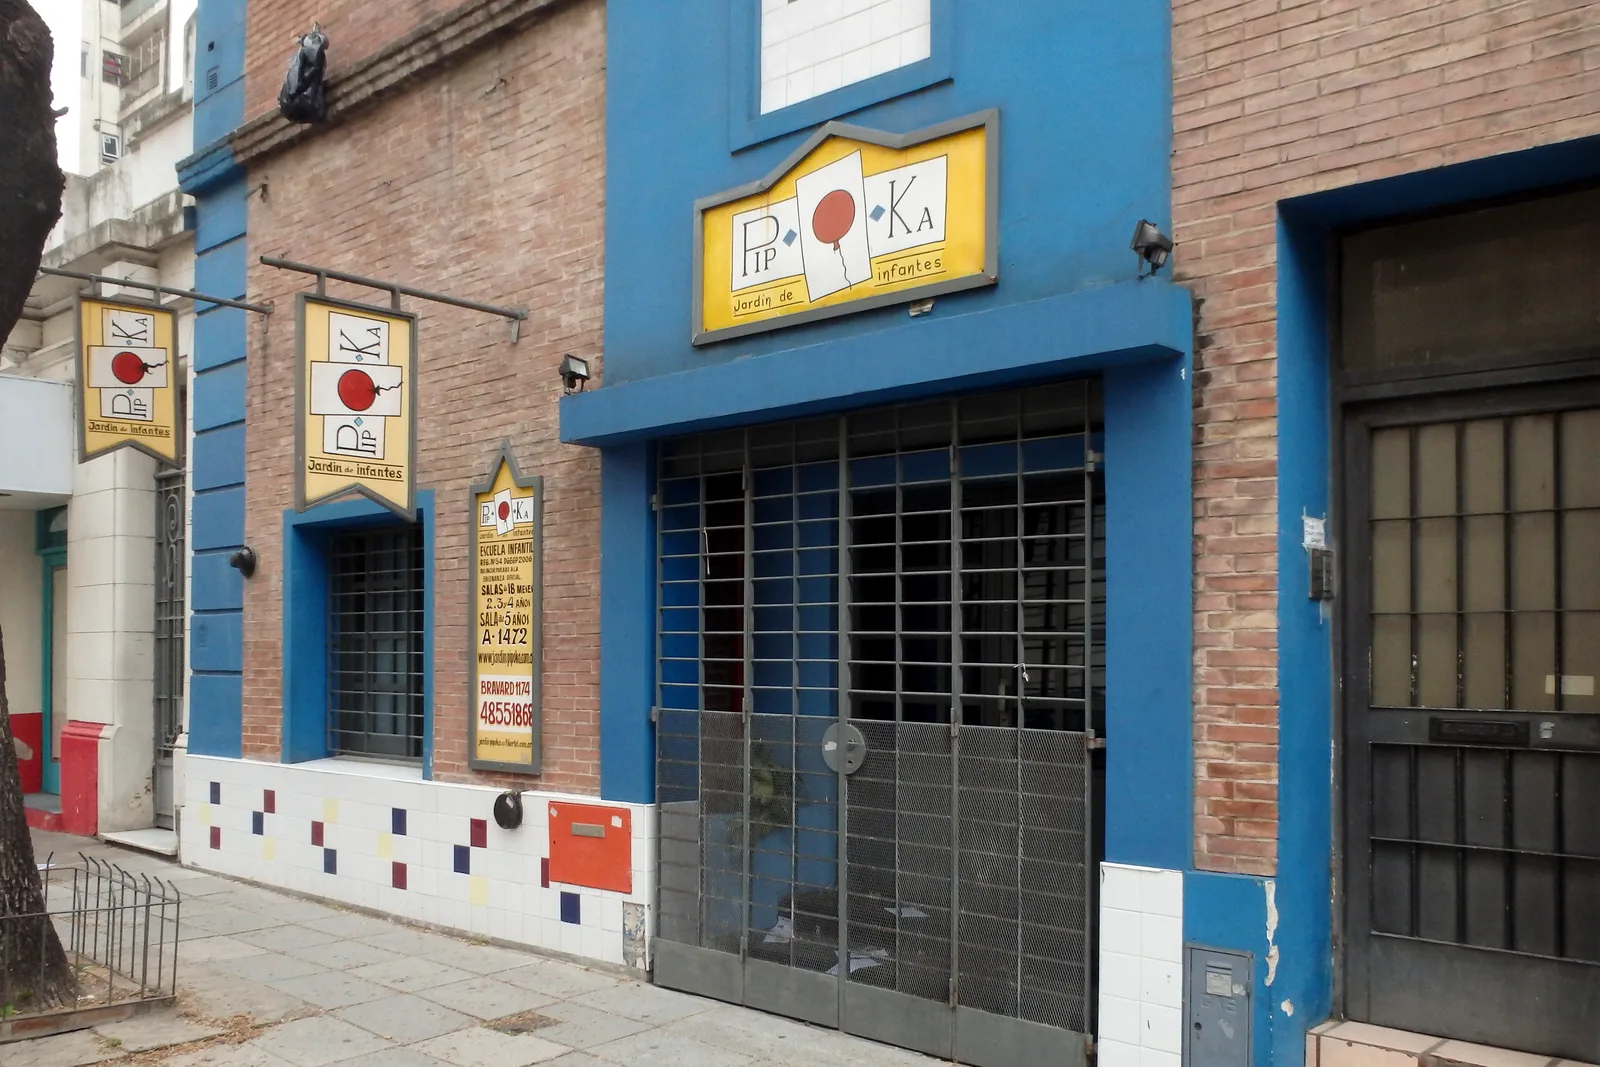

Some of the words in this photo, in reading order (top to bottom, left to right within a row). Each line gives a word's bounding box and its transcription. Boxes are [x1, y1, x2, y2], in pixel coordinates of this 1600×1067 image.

[877, 257, 942, 281] infantes
[733, 294, 772, 312] Jardin
[779, 289, 794, 302] de
[88, 421, 118, 432] Jardin
[130, 424, 170, 436] infantes
[308, 459, 342, 473] Jardin
[356, 463, 402, 479] infantes
[480, 544, 506, 557] ESCUELA
[507, 542, 533, 555] INFANTIL
[481, 583, 504, 596] SALAS
[508, 583, 515, 595] 18
[480, 612, 498, 626] SALA
[504, 611, 511, 626] 5
[512, 612, 529, 625] AÑOS
[481, 681, 515, 695] BRAVARD
[515, 681, 530, 696] 1174
[480, 701, 533, 727] 48551868
